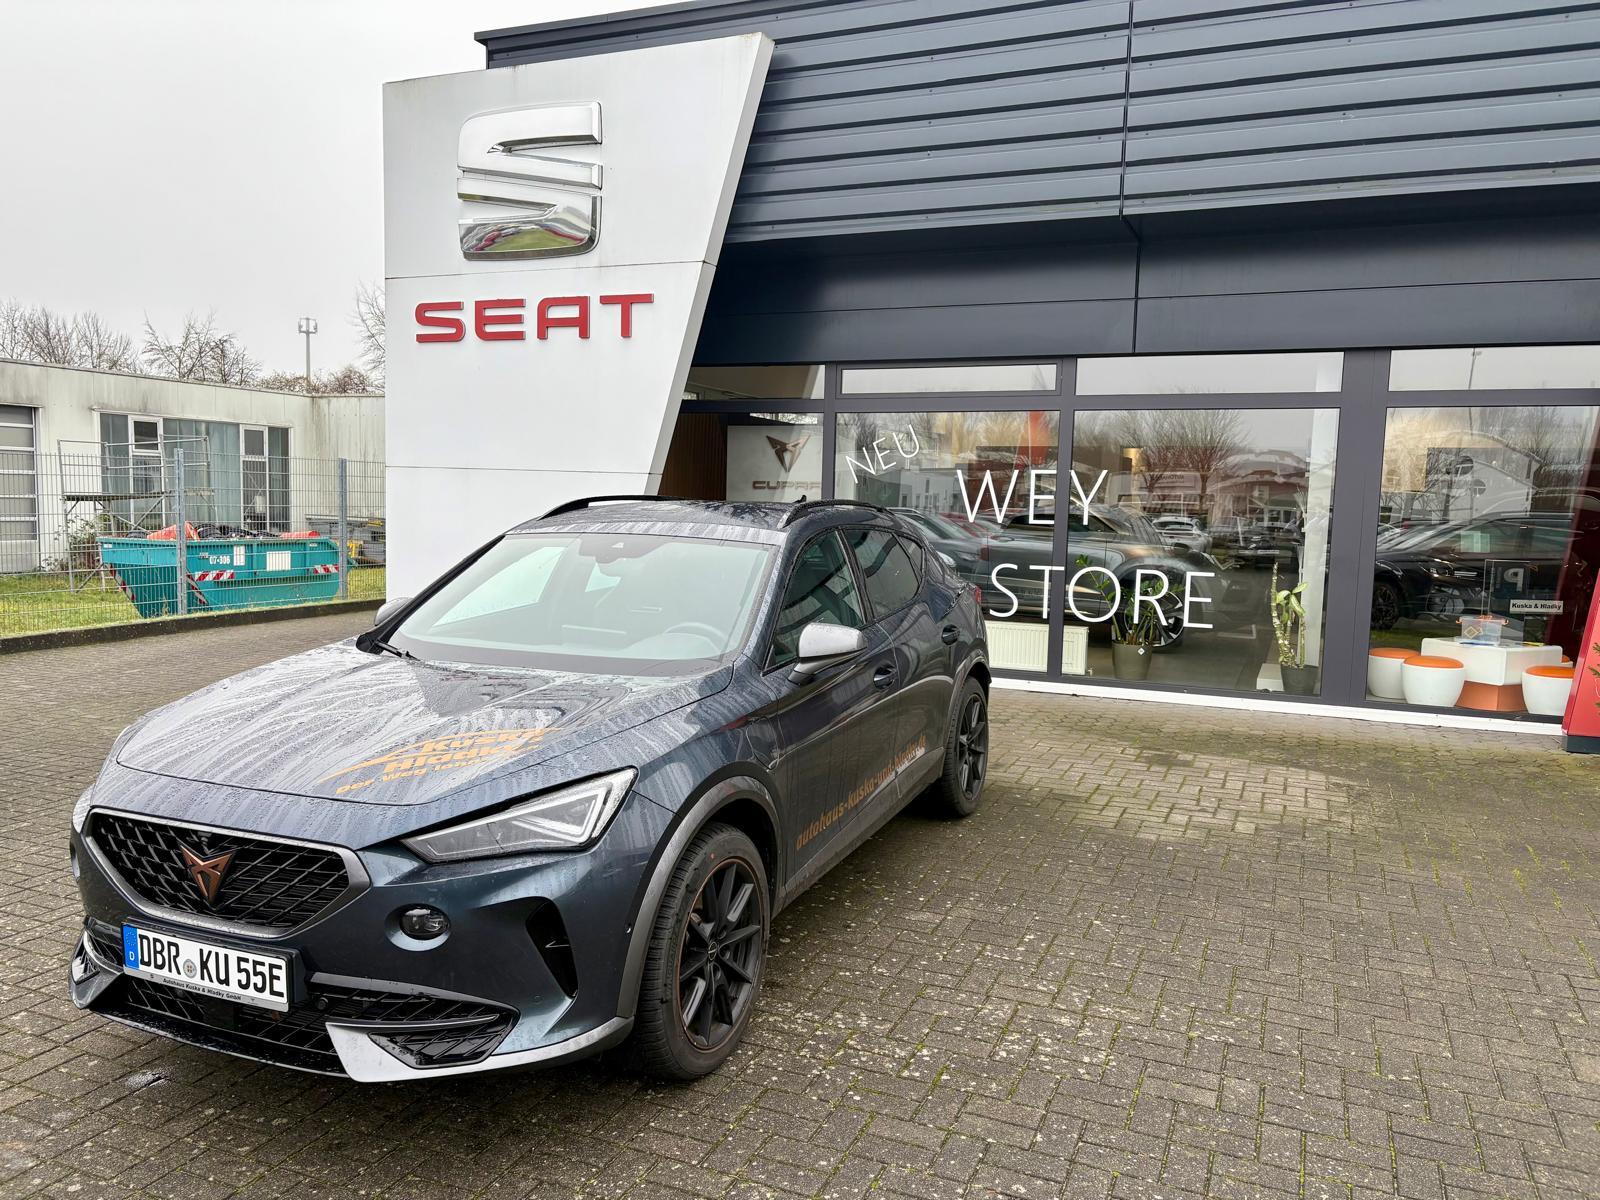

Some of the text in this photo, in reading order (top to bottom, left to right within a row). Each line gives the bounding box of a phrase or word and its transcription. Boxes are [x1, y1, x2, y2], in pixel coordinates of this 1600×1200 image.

[415, 292, 655, 344] SEAT
[845, 424, 920, 484] NEU
[956, 469, 1108, 526] WEY
[989, 563, 1216, 629] STORE
[129, 951, 135, 961] D
[138, 934, 285, 998] DBR KU 55E
[163, 978, 185, 988] Autohaus
[185, 983, 201, 992] Kuska
[226, 993, 242, 1001] GmbH
